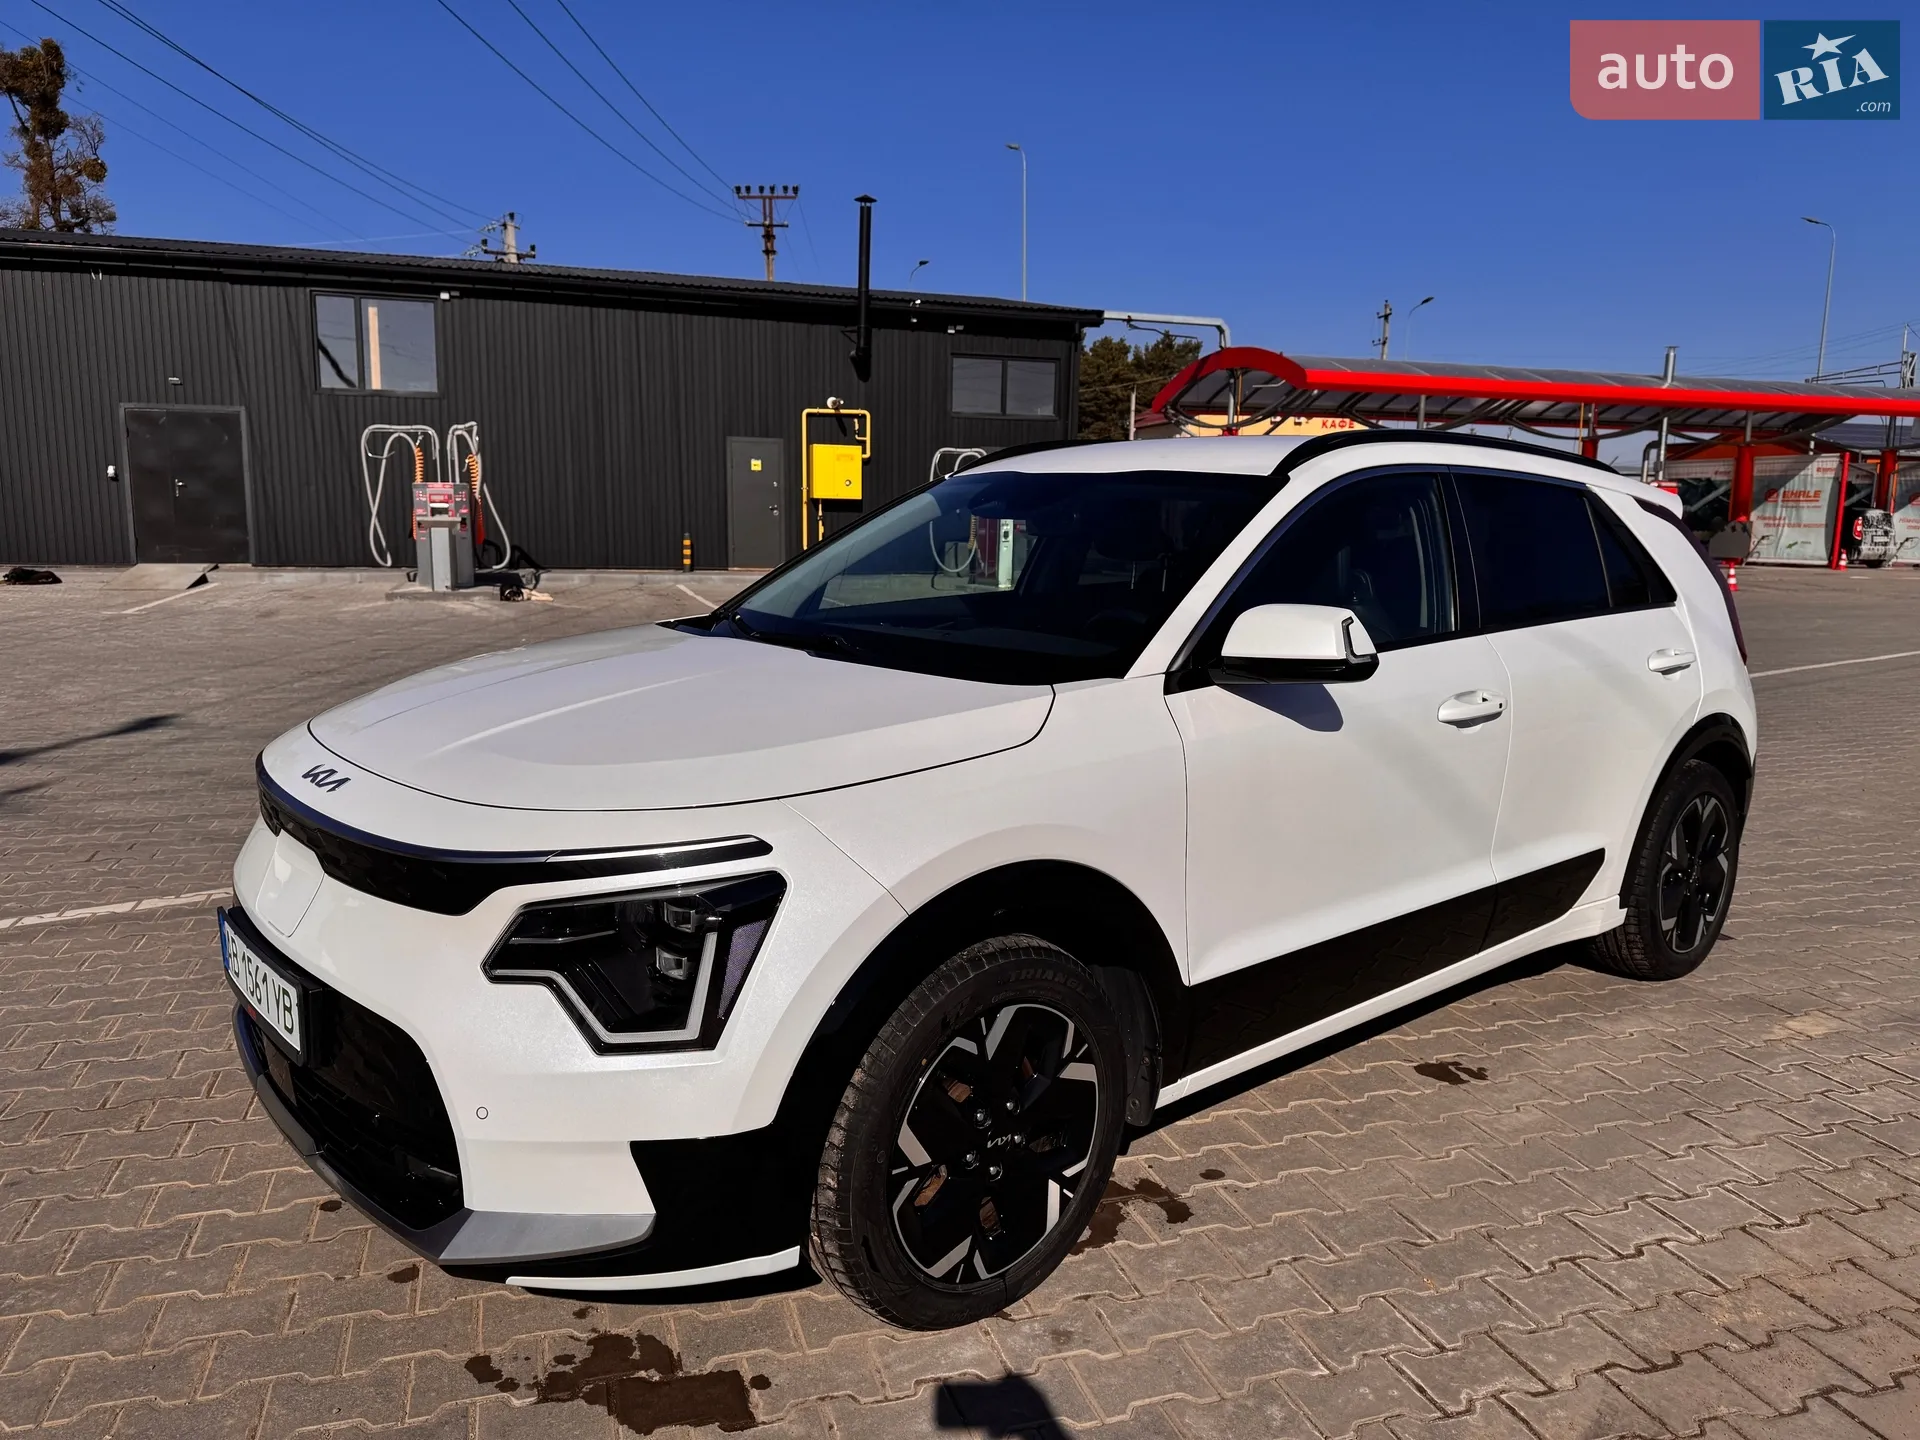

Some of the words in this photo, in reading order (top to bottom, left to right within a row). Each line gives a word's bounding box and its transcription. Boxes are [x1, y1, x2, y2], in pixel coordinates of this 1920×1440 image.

[1321, 419, 1355, 429] КАФЕ
[241, 949, 270, 1014] 1561
[271, 978, 294, 1035] YB
